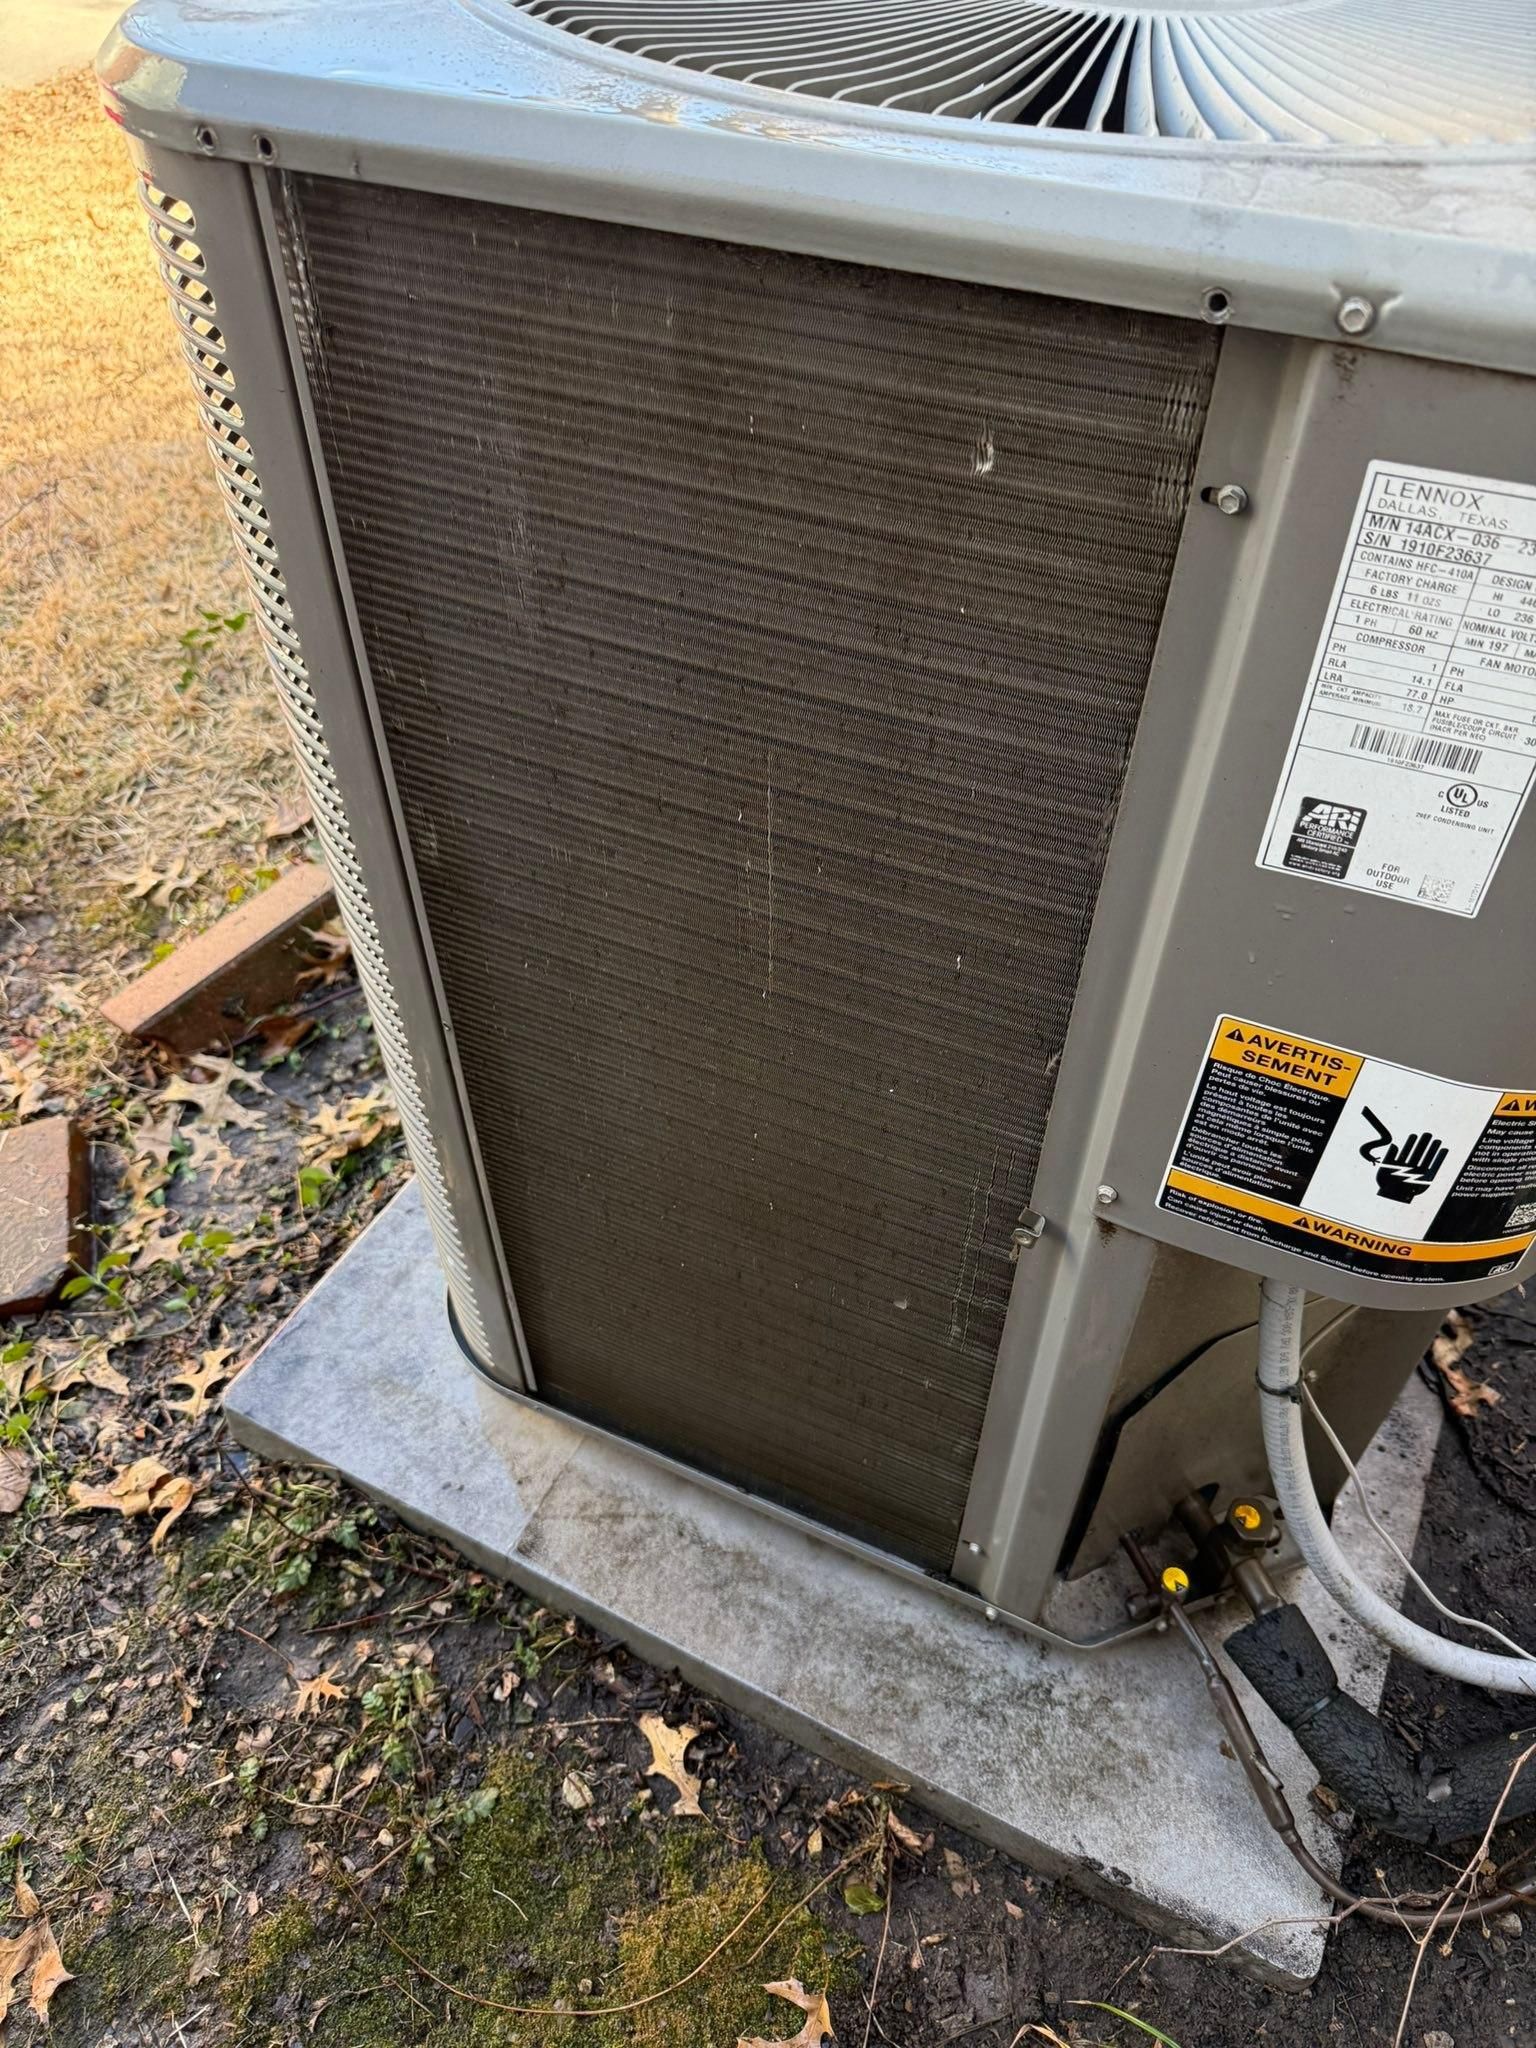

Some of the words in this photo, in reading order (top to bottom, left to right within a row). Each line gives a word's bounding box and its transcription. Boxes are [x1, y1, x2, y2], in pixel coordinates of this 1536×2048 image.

[1384, 479, 1485, 511] LENNOX
[1368, 515, 1401, 532] M/N
[1459, 512, 1509, 530] TEXAS
[1363, 531, 1392, 548] S/N
[1400, 538, 1493, 566] 1910F23637
[1360, 551, 1414, 568] CONTAINS
[1416, 561, 1474, 580] HFC-410A
[1364, 568, 1413, 585] FACTORY
[1416, 578, 1459, 595] CHARGE
[1492, 575, 1533, 590] DESIGN
[1370, 585, 1378, 595] 6
[1380, 588, 1399, 600] LBS
[1492, 592, 1504, 602] HI
[1350, 598, 1411, 618] ELECTRICAL
[1414, 611, 1453, 627] RATING
[1488, 608, 1500, 617] LO
[1514, 612, 1534, 624] 236
[1364, 618, 1378, 627] PH
[1462, 620, 1506, 638] NOMINAL
[1408, 624, 1423, 636] 60
[1426, 630, 1439, 640] HZ
[1332, 642, 1347, 653] PH
[1356, 632, 1426, 654] COMPRESSOR
[1465, 638, 1484, 648] MIN
[1489, 641, 1509, 652] 197
[1328, 657, 1347, 669] RLA
[1412, 675, 1432, 686] 14.1
[1450, 666, 1465, 677] PH
[1480, 657, 1502, 669] FAN
[1324, 672, 1343, 682] LRA
[1406, 688, 1428, 700] 77.0
[1444, 681, 1464, 693] FLA
[1440, 696, 1455, 706] HP
[1453, 788, 1468, 804] UL
[1477, 800, 1489, 808] US
[1440, 805, 1470, 818] LISTED
[1300, 821, 1354, 839] PERFORMANCE
[1433, 816, 1476, 830] CONDENSING
[1366, 868, 1410, 885] OUTDOOR
[1382, 863, 1400, 873] FOR
[1376, 880, 1394, 890] USE
[1248, 1034, 1352, 1071] AVERTIS-
[1214, 1062, 1244, 1076] Risque
[1258, 1076, 1282, 1087] Choc
[1242, 1050, 1338, 1086] SEMENT
[1208, 1076, 1236, 1087] pertes
[1211, 1068, 1232, 1078] Peut
[1233, 1076, 1263, 1088] causer
[1264, 1084, 1306, 1102] blessures
[1200, 1102, 1216, 1110] des
[1219, 1087, 1238, 1097] haut
[1240, 1094, 1272, 1108] voltage
[1289, 1109, 1325, 1124] toujours
[1246, 1102, 1272, 1114] toutes
[1274, 1110, 1288, 1119] les
[1202, 1096, 1259, 1116] composantes
[1302, 1128, 1324, 1136] avec
[1190, 1132, 1222, 1146] sources
[1221, 1128, 1246, 1138] mode
[1254, 1130, 1286, 1144] lorsque
[1262, 1127, 1290, 1139] simple
[1242, 1142, 1268, 1154] toutes
[1237, 1154, 1272, 1168] distance
[1274, 1166, 1298, 1176] avant
[1211, 1160, 1230, 1170] peut
[1232, 1168, 1252, 1176] avoir
[1254, 1174, 1292, 1190] plusieurs
[1167, 1196, 1183, 1204] Can
[1184, 1202, 1208, 1213] cause
[1210, 1210, 1232, 1222] injury
[1169, 1188, 1186, 1198] Risk
[1198, 1200, 1236, 1215] explosion
[1165, 1202, 1197, 1217] Recover
[1198, 1215, 1240, 1232] refrigerant
[1241, 1229, 1260, 1238] from
[1261, 1235, 1302, 1253] Discharge
[1314, 1221, 1412, 1256] WARNING
